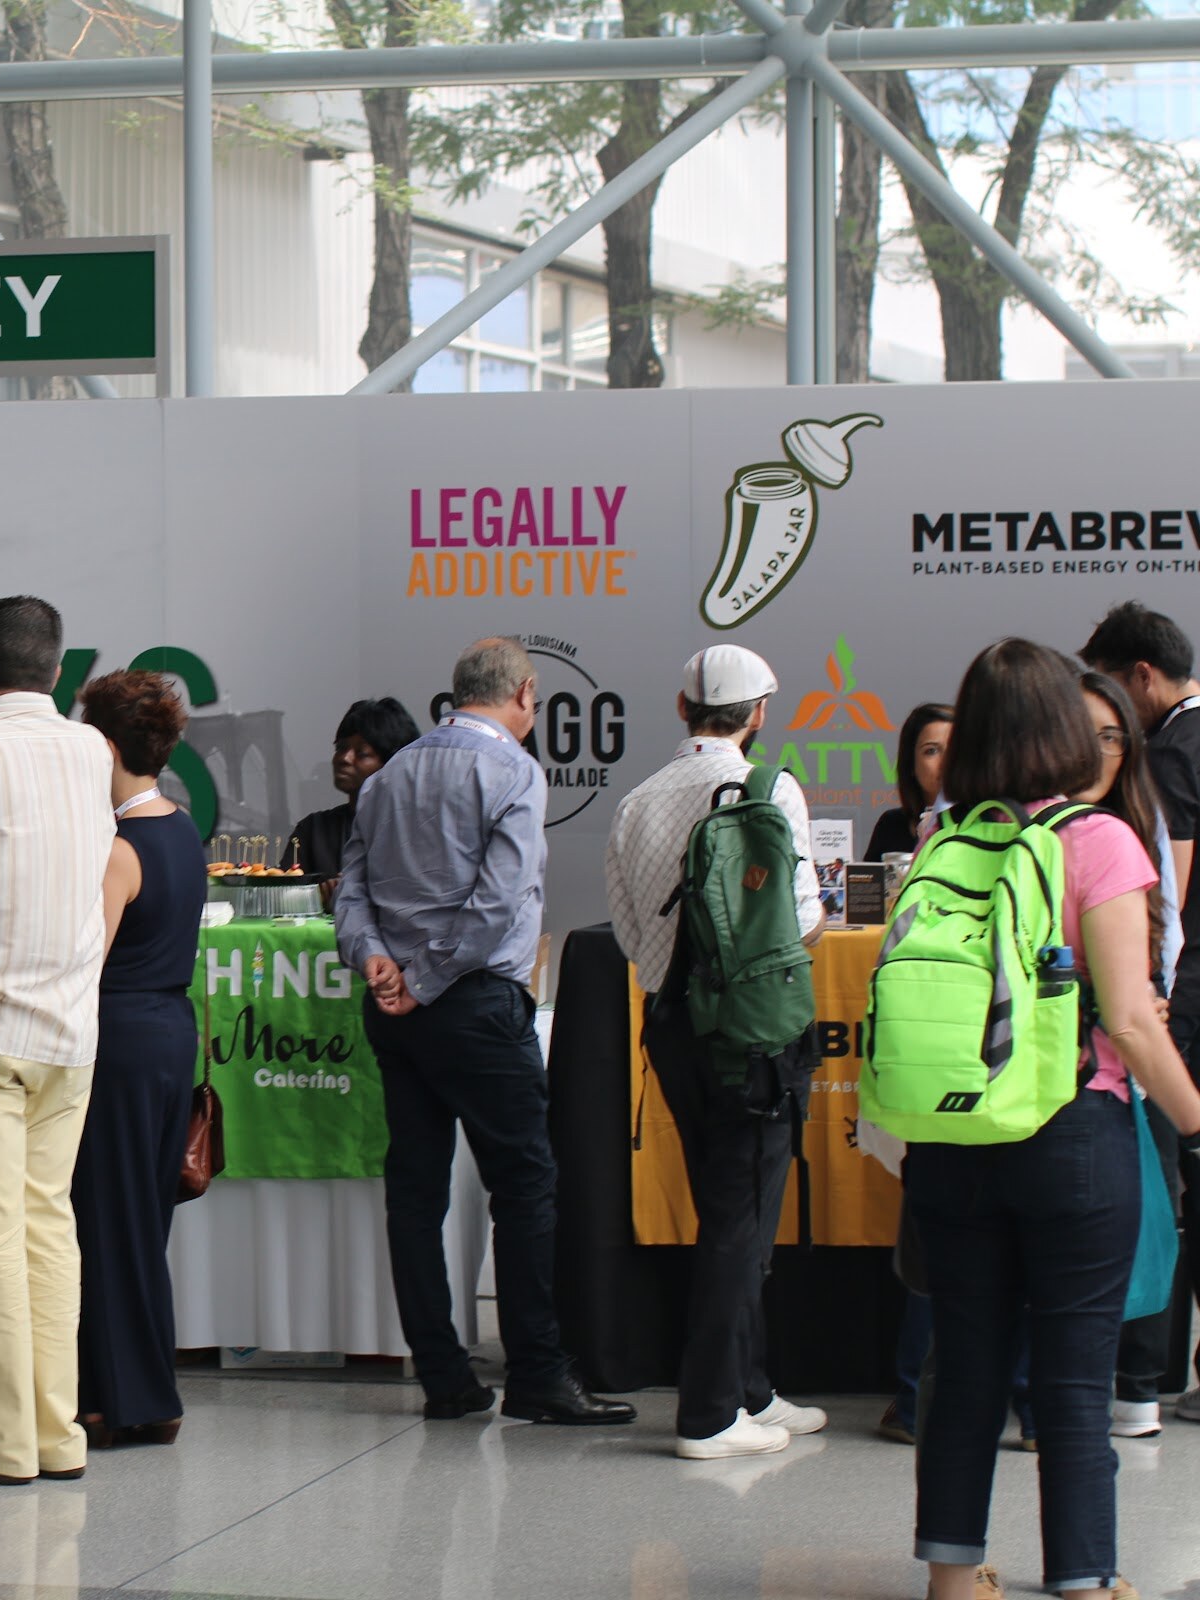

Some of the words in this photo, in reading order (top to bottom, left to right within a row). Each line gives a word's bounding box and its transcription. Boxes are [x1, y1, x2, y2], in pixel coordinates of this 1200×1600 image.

[410, 485, 627, 548] LEGALLY
[911, 510, 1200, 553] METABRE
[406, 550, 629, 598] ADDICTIVE
[731, 551, 790, 611] JALAPA
[783, 507, 806, 543] JAR
[912, 560, 1045, 575] PLANT-BASED
[1052, 559, 1128, 573] ENERGY
[1136, 559, 1200, 573] ON-TH
[746, 741, 898, 785] SATTV
[211, 1004, 354, 1065] More
[254, 1067, 351, 1095] Catering
